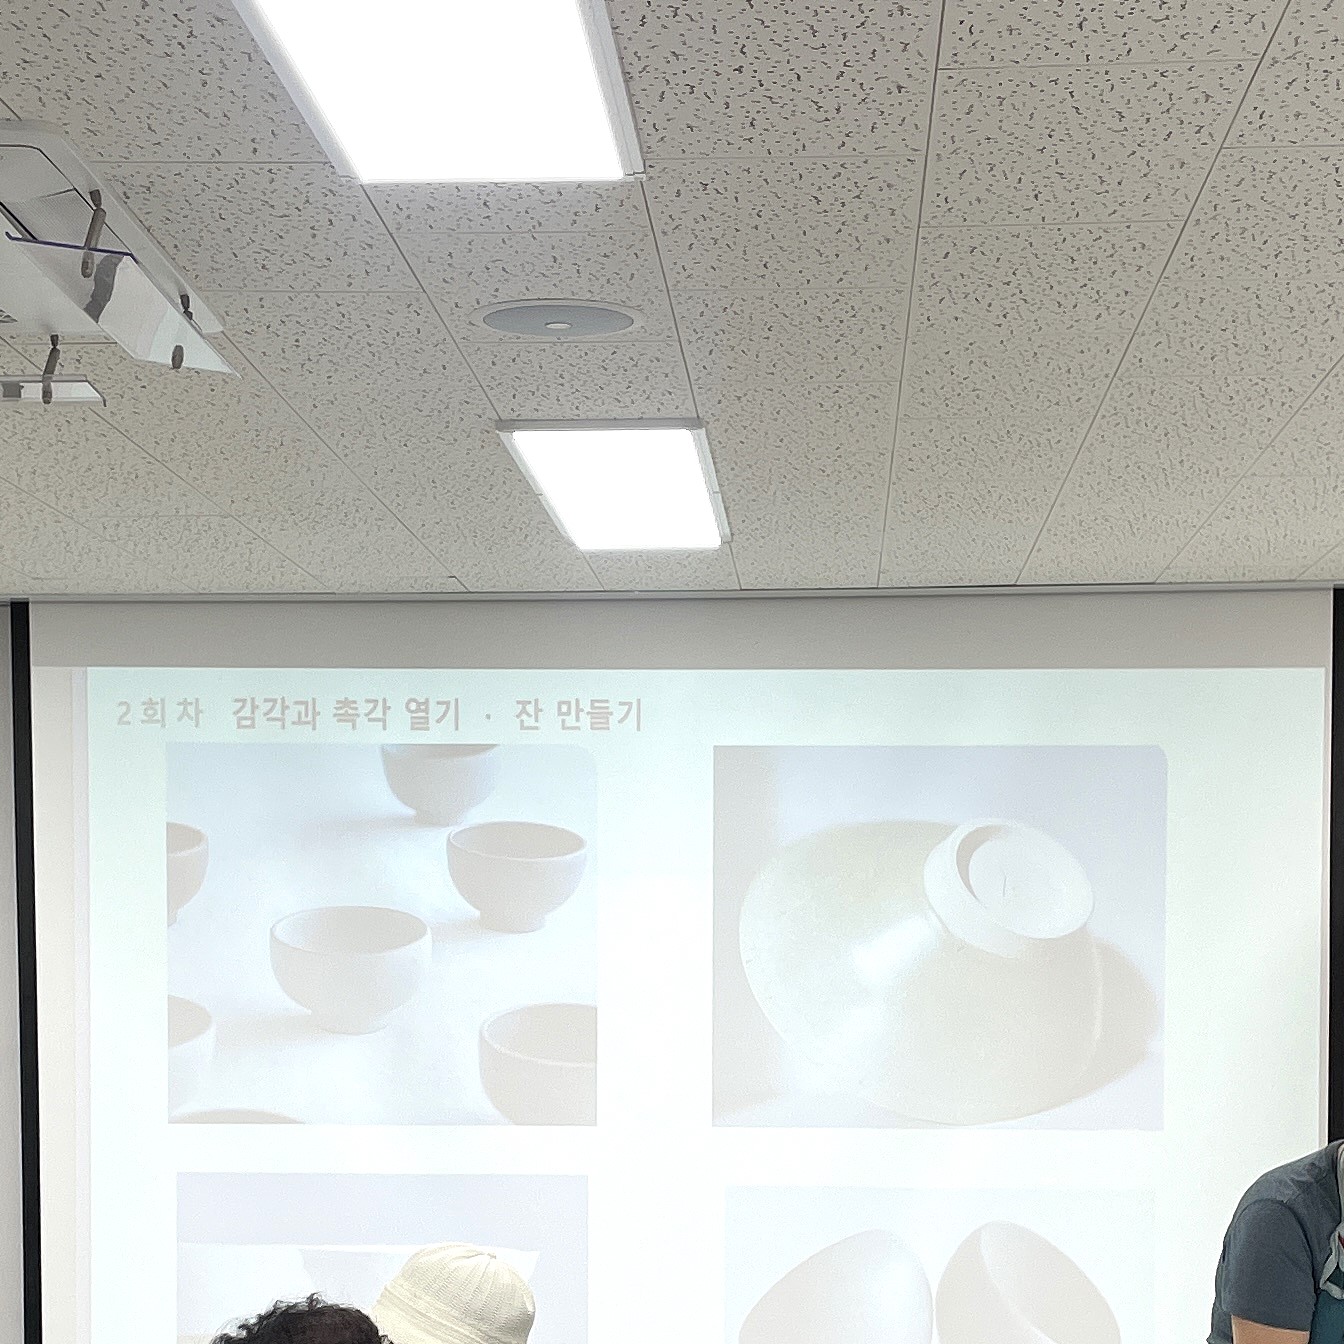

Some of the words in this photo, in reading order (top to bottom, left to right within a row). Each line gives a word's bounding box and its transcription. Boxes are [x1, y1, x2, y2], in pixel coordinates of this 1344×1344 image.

[231, 697, 322, 732] 감각과
[332, 697, 393, 732] 촉각
[404, 697, 461, 733] 열기
[515, 697, 545, 732] 잔
[557, 697, 644, 733] 만들기
